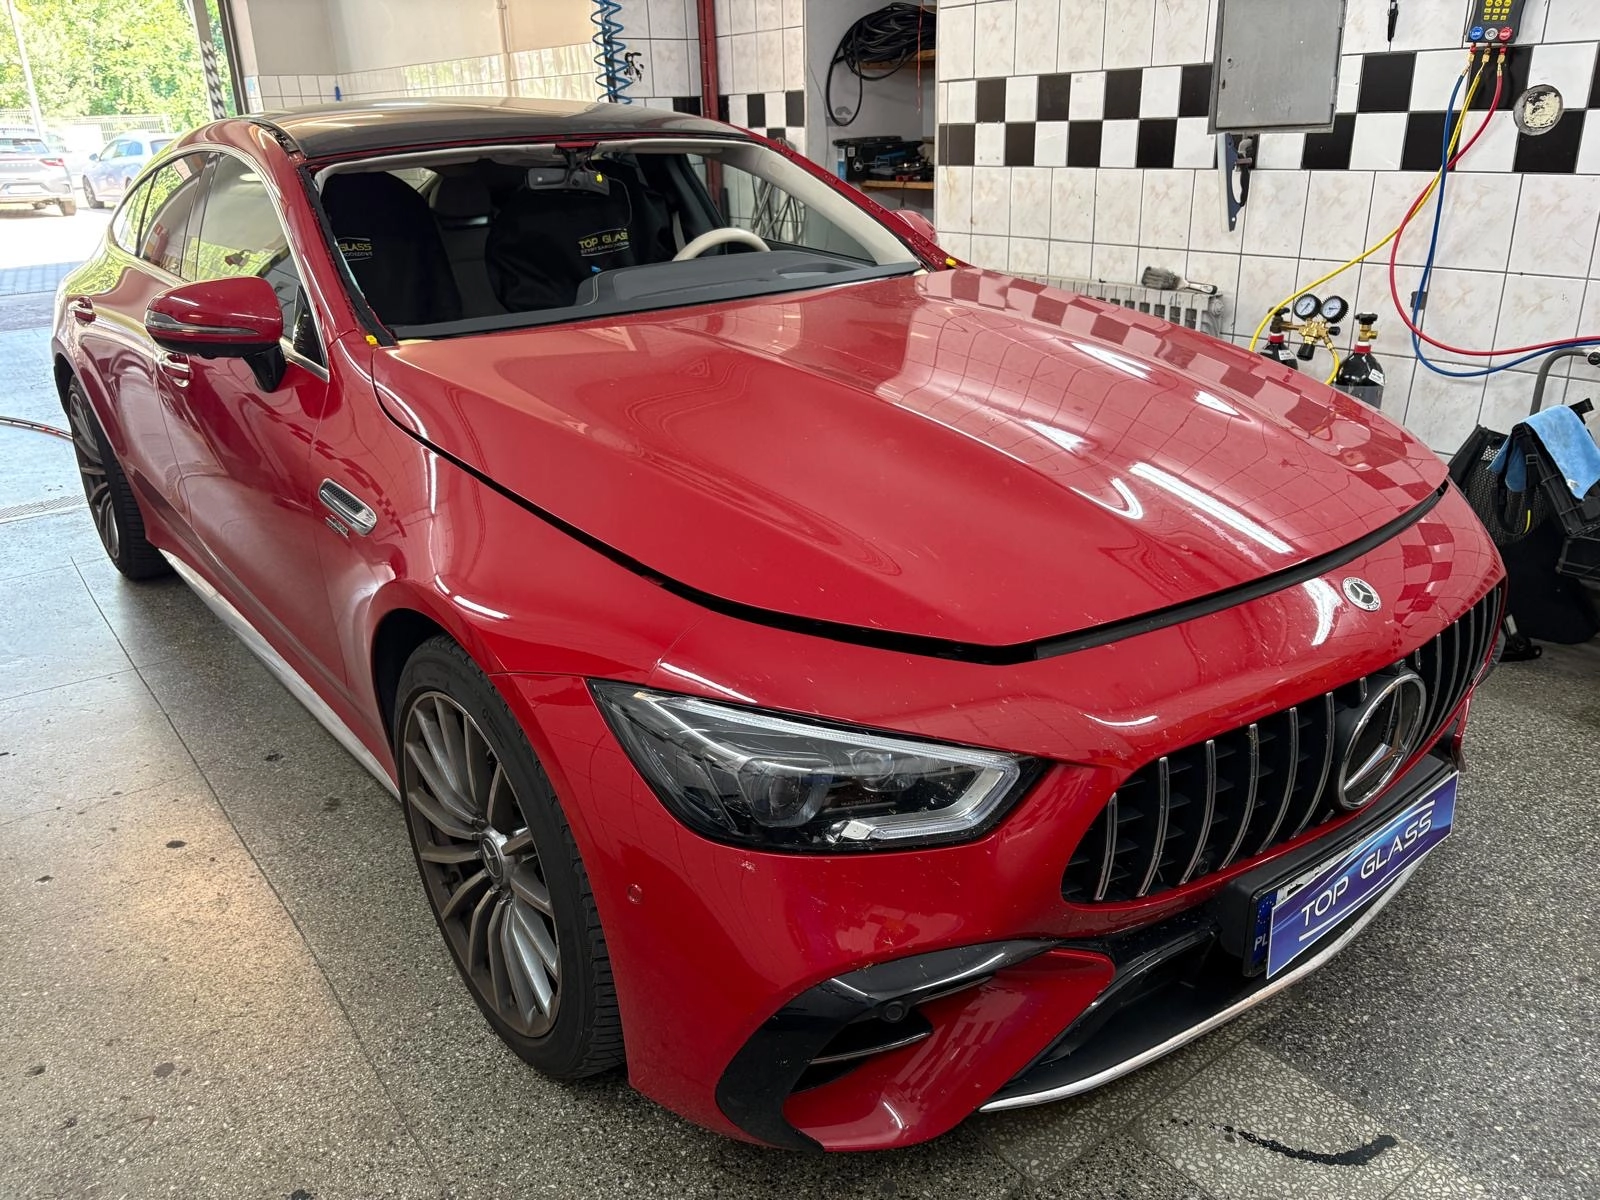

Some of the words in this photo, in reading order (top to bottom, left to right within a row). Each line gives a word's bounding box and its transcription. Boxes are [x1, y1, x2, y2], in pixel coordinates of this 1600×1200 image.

[339, 243, 373, 252] GLASS
[578, 237, 598, 249] TOP
[1301, 876, 1349, 927] TOP
[1360, 810, 1433, 880] GLASS
[1254, 933, 1268, 951] PL
